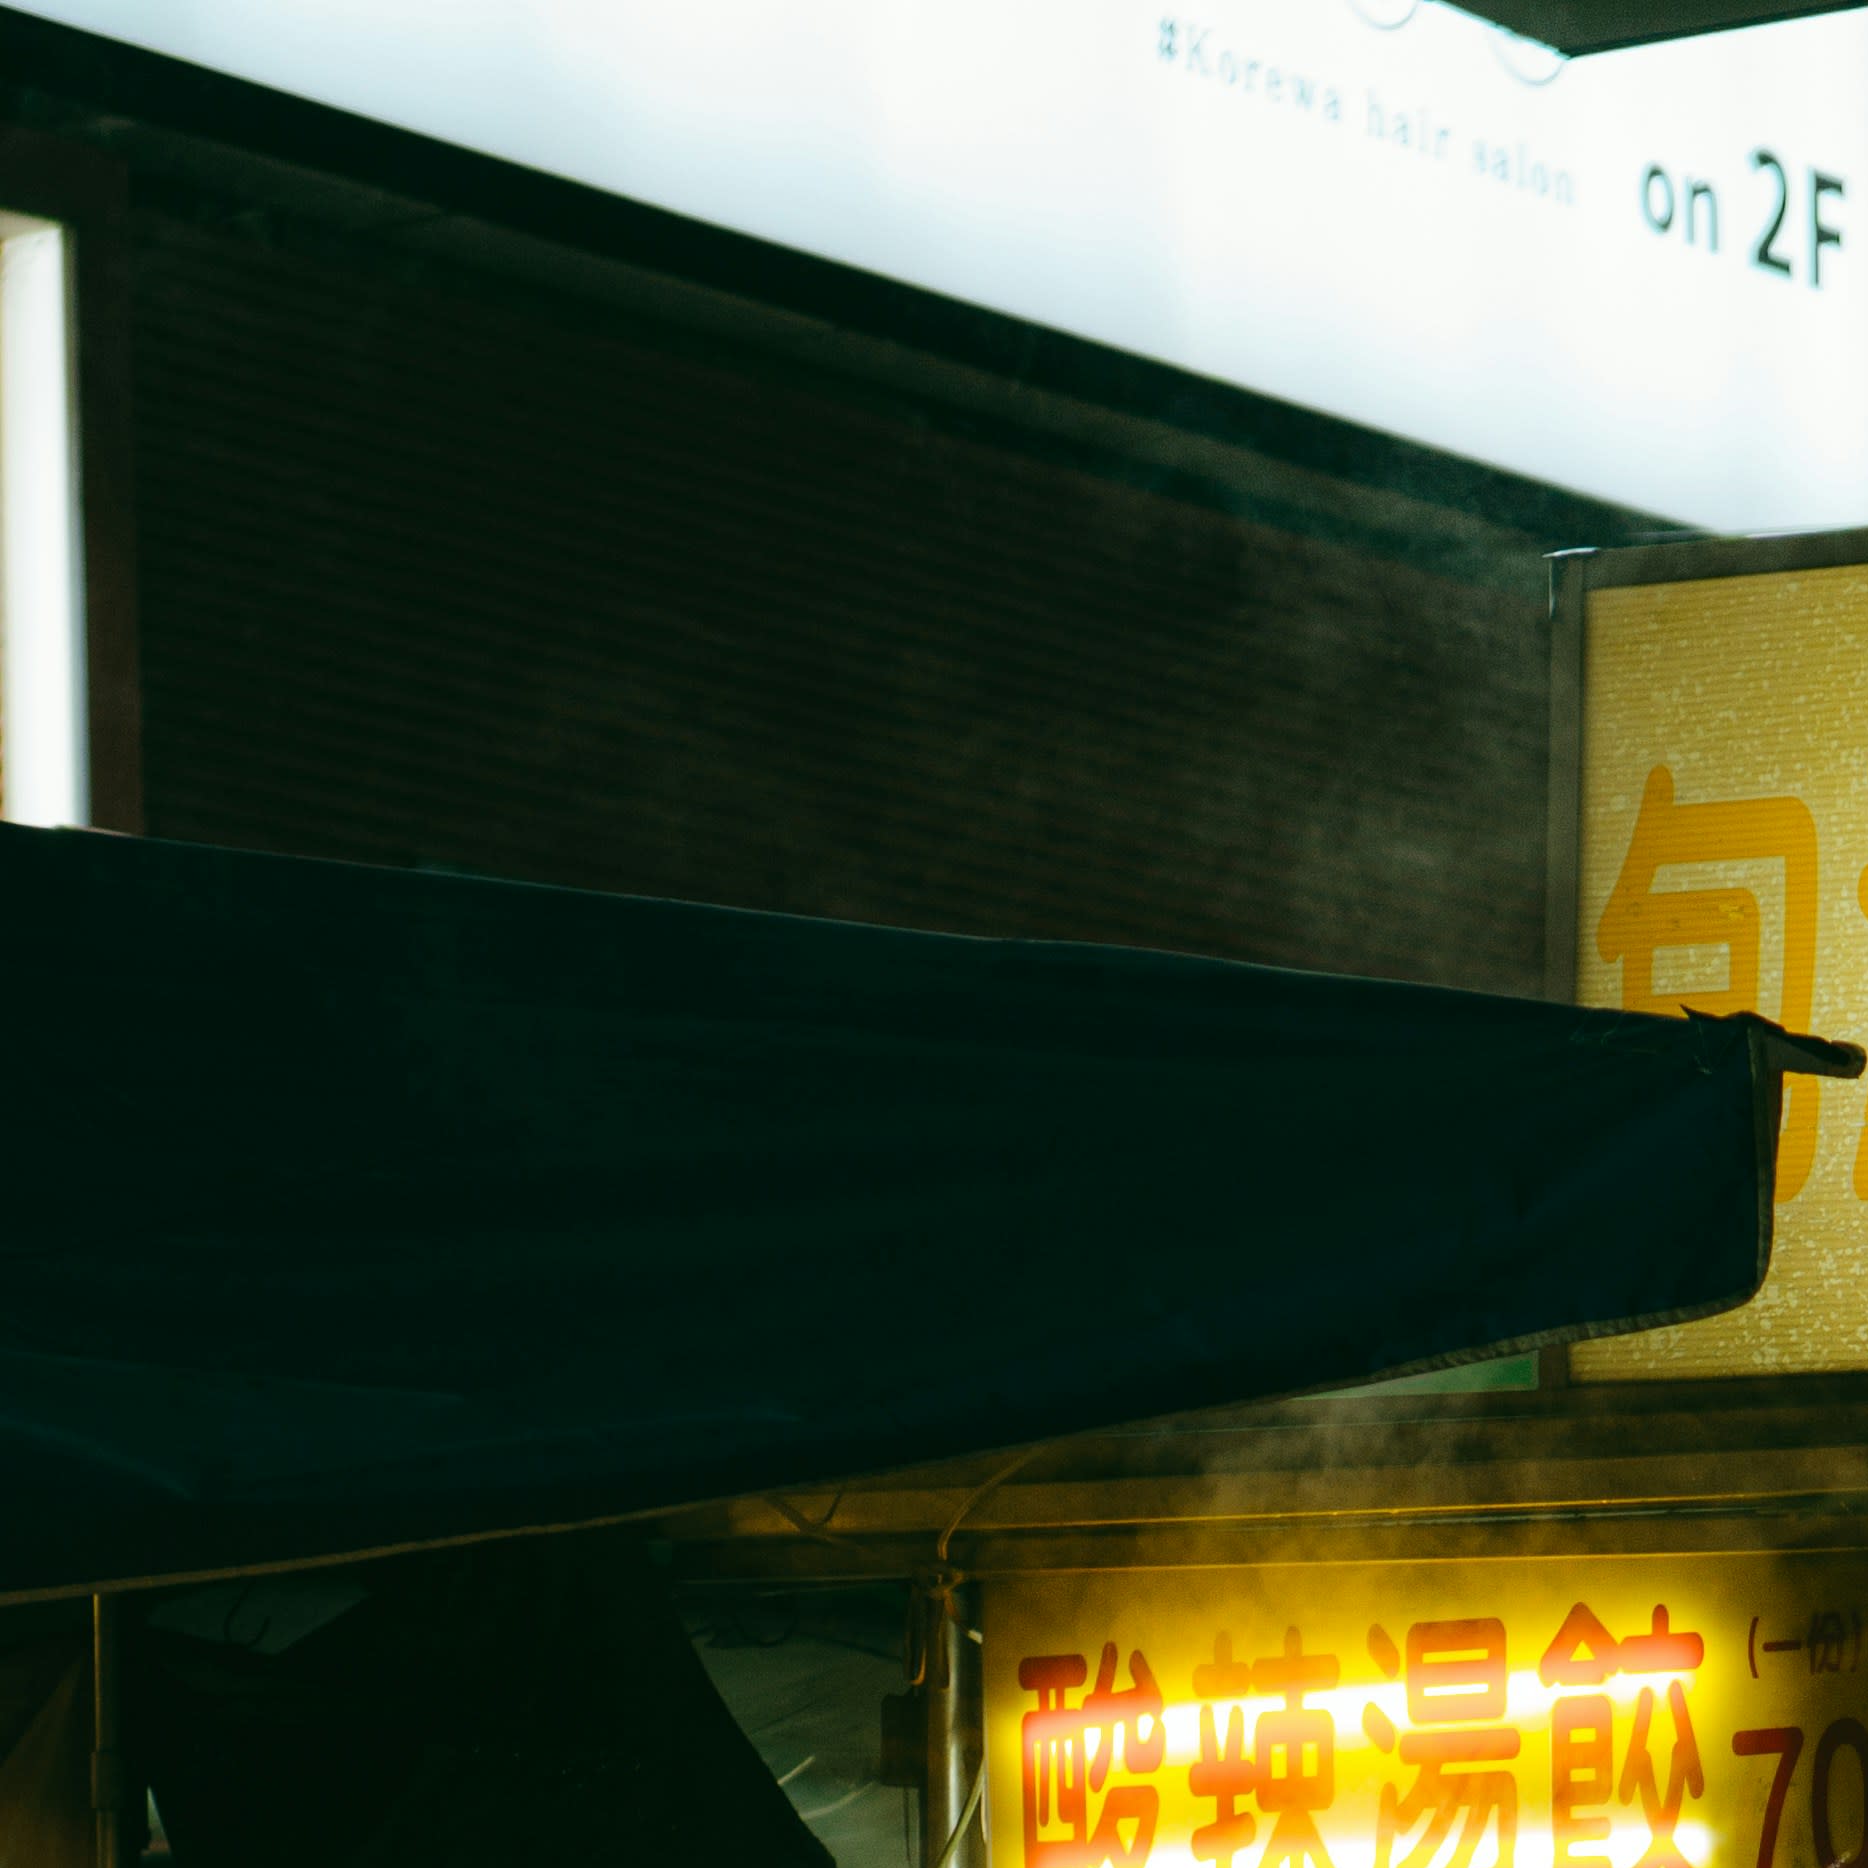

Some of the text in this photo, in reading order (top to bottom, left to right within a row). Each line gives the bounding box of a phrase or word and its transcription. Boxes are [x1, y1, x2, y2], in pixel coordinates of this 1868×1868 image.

[1365, 85, 1452, 159] hair
[1473, 138, 1576, 206] salon
[1641, 148, 1847, 288] on 2F
